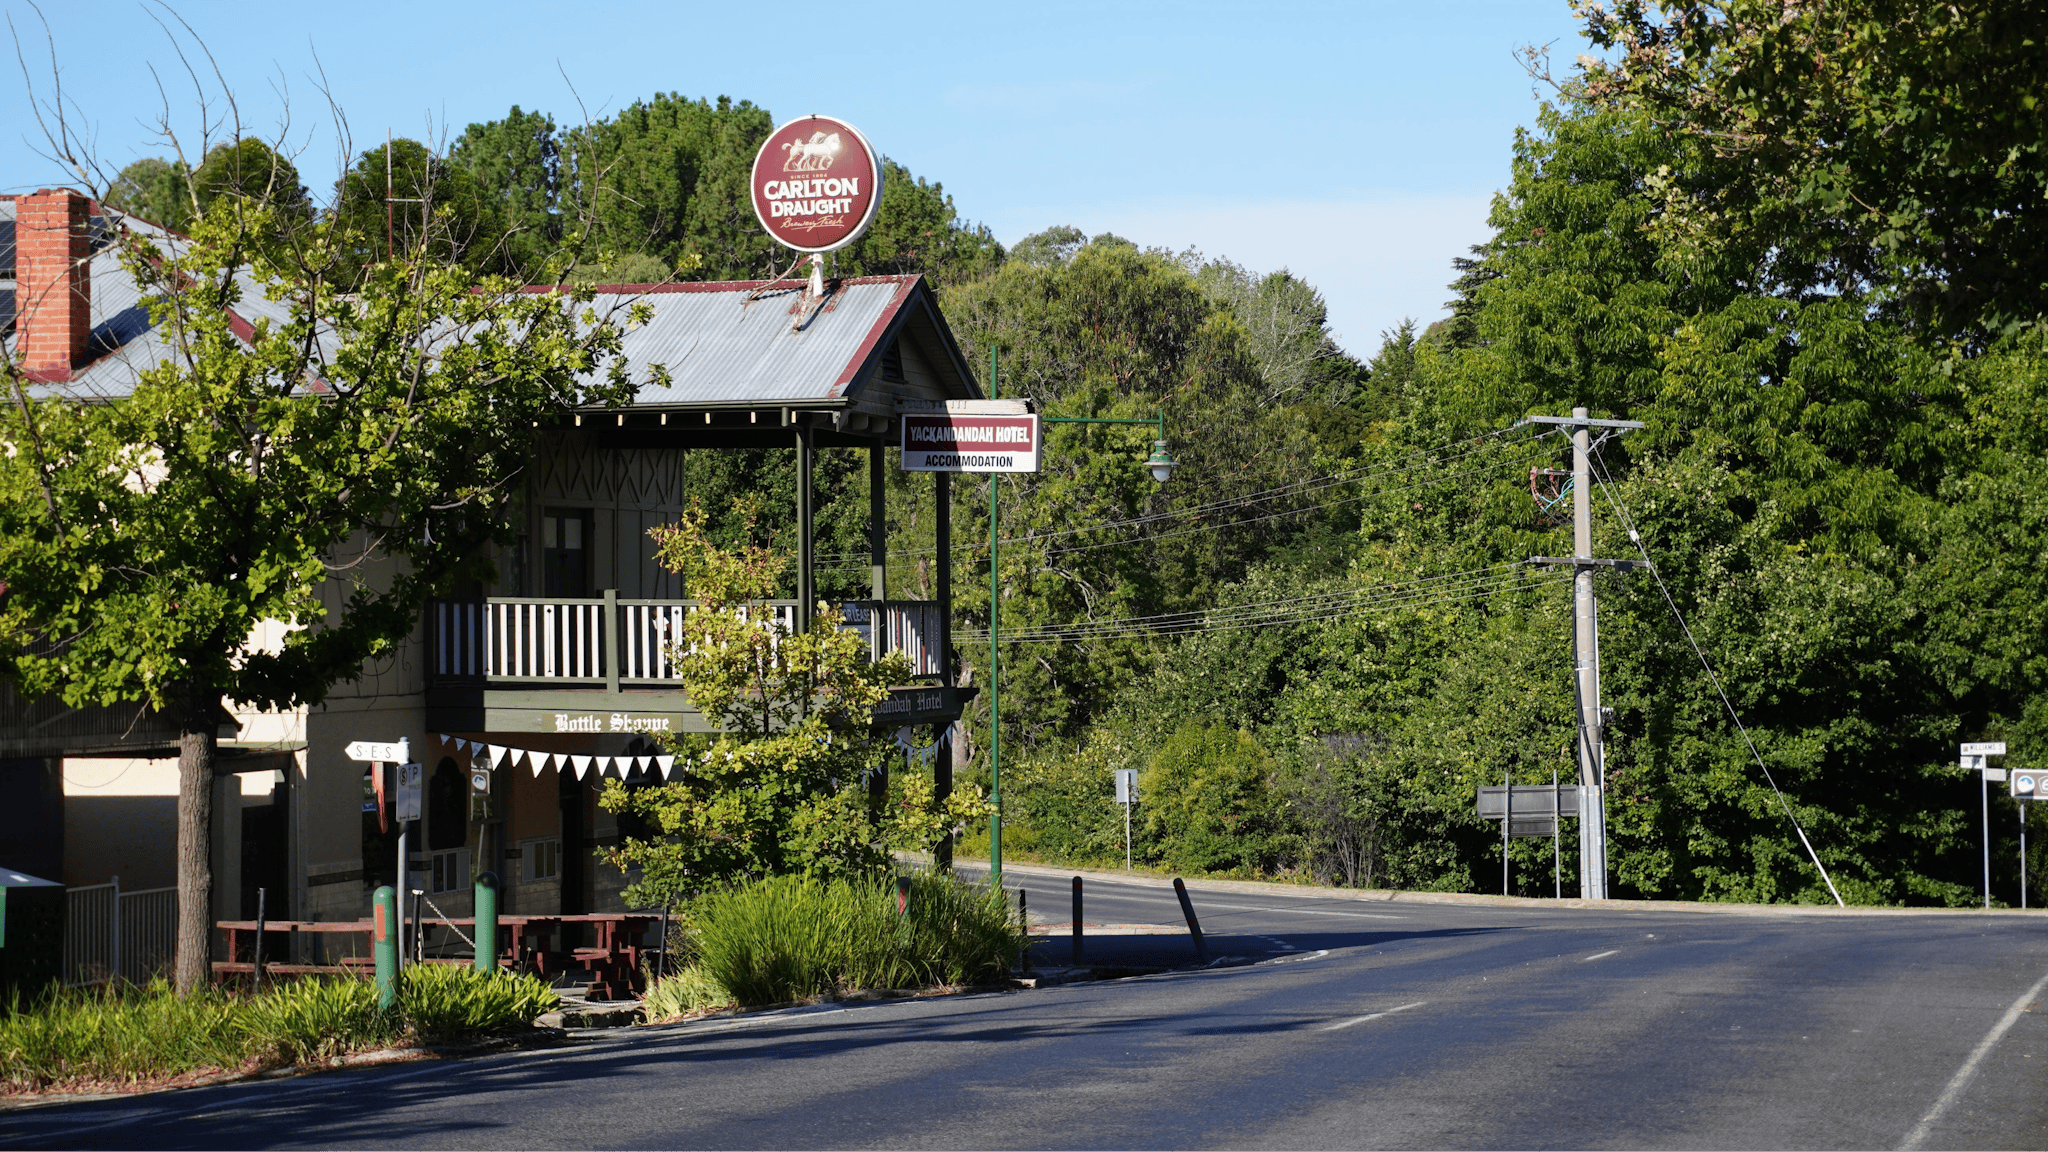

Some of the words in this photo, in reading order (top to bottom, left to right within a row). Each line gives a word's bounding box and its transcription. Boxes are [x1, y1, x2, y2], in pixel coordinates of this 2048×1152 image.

[764, 178, 859, 200] CARLTON
[770, 198, 852, 217] DRAUGHT
[780, 217, 817, 232] Brewery
[817, 215, 845, 228] Fresh
[910, 426, 994, 443] YACKANDANDAH
[995, 426, 1030, 443] HOTEL
[925, 455, 1013, 467] ACCOMMODATION
[843, 608, 853, 622] OR
[853, 608, 870, 622] LEASE
[916, 692, 943, 711] Hotel
[554, 713, 602, 732] Bottle
[609, 713, 669, 732] Shoppe
[413, 766, 418, 780] P
